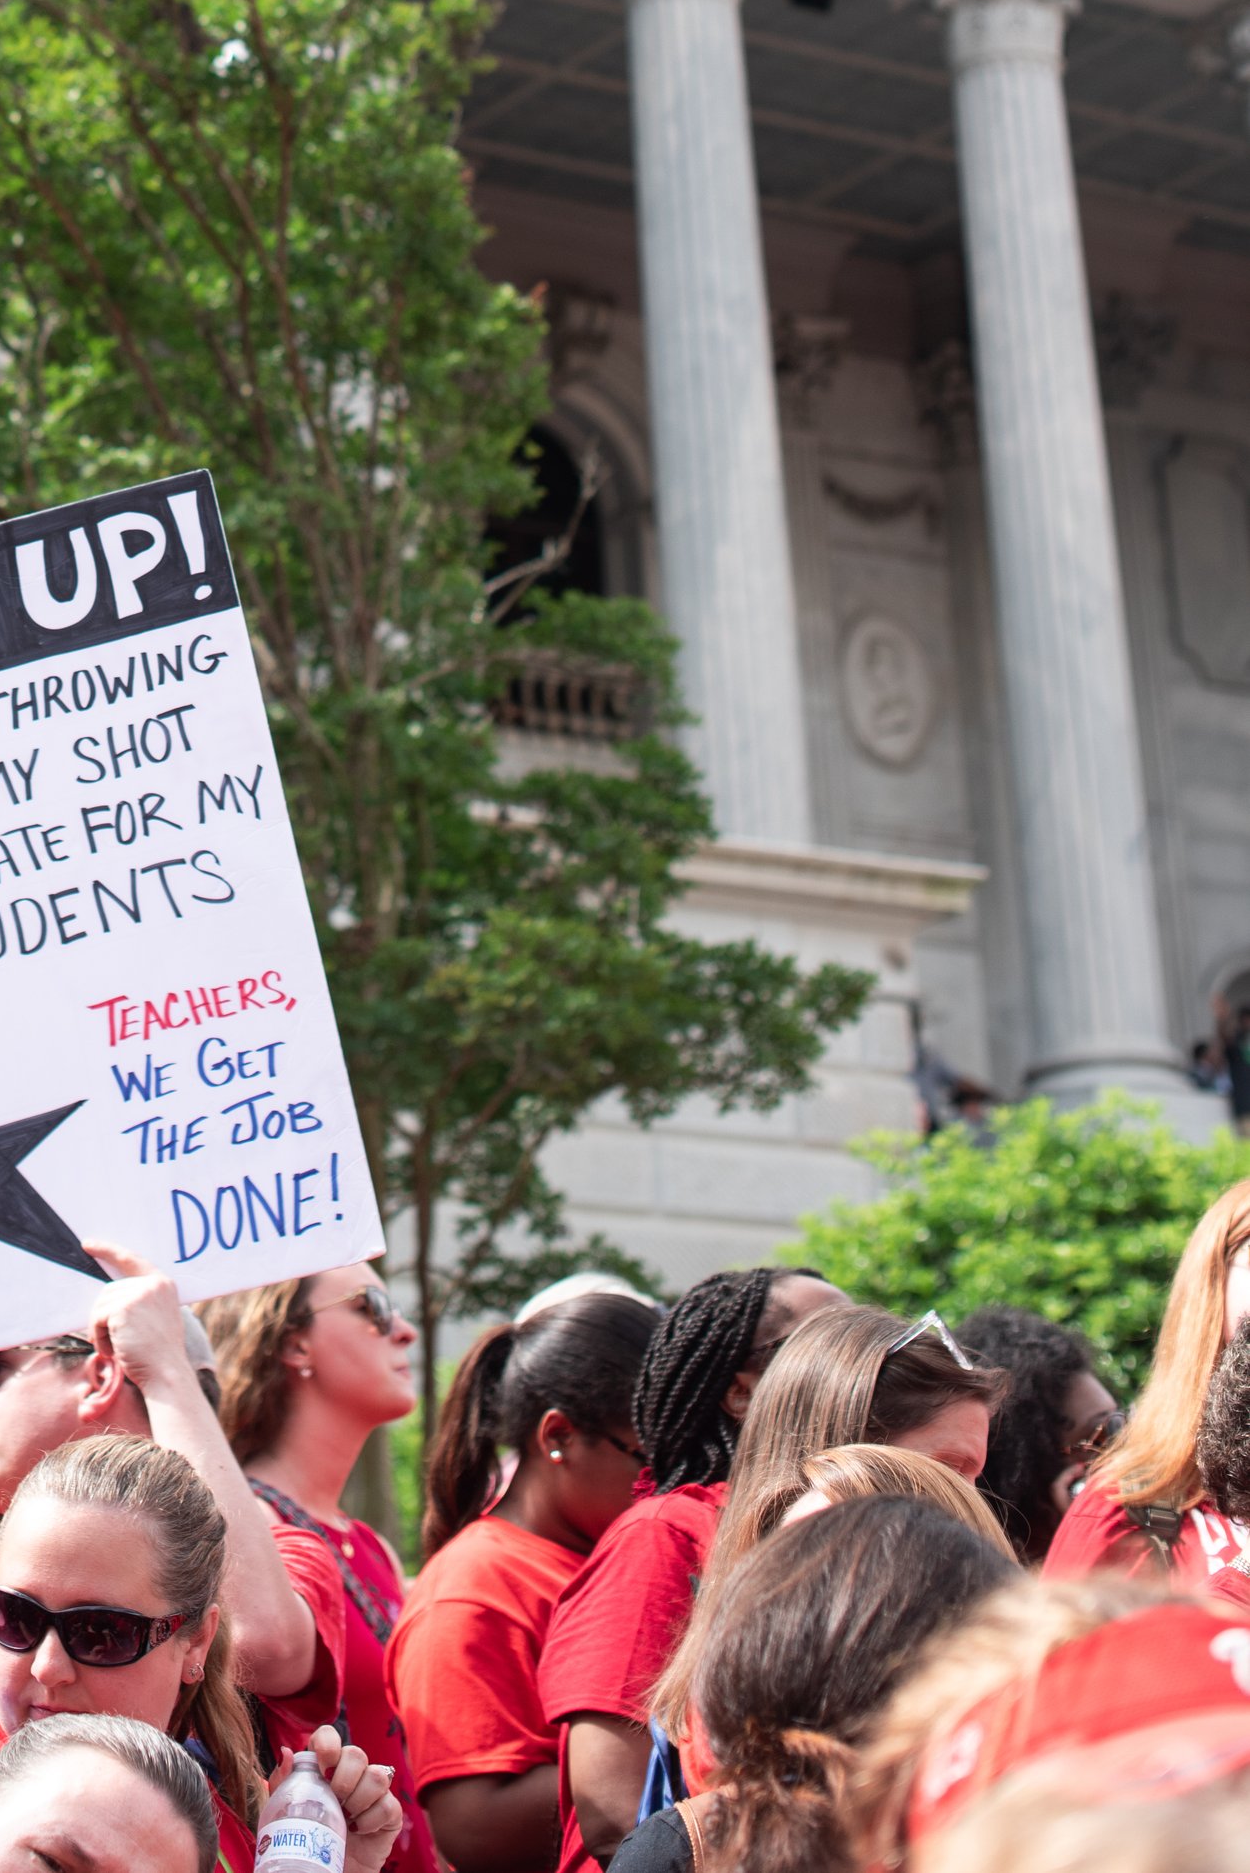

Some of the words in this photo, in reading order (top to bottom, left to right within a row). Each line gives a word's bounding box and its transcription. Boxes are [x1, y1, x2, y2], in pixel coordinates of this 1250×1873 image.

[16, 491, 212, 629] UP!
[73, 704, 195, 784] SHOT
[81, 793, 183, 854] FOR
[198, 765, 263, 824] MY
[87, 970, 296, 1047] TEACHERS,
[111, 1057, 175, 1102] WE
[198, 1038, 285, 1087] GET
[121, 1116, 206, 1164] THE
[221, 1091, 323, 1145] JOB
[171, 1153, 343, 1263] DONE!
[273, 1833, 307, 1847] WATER
